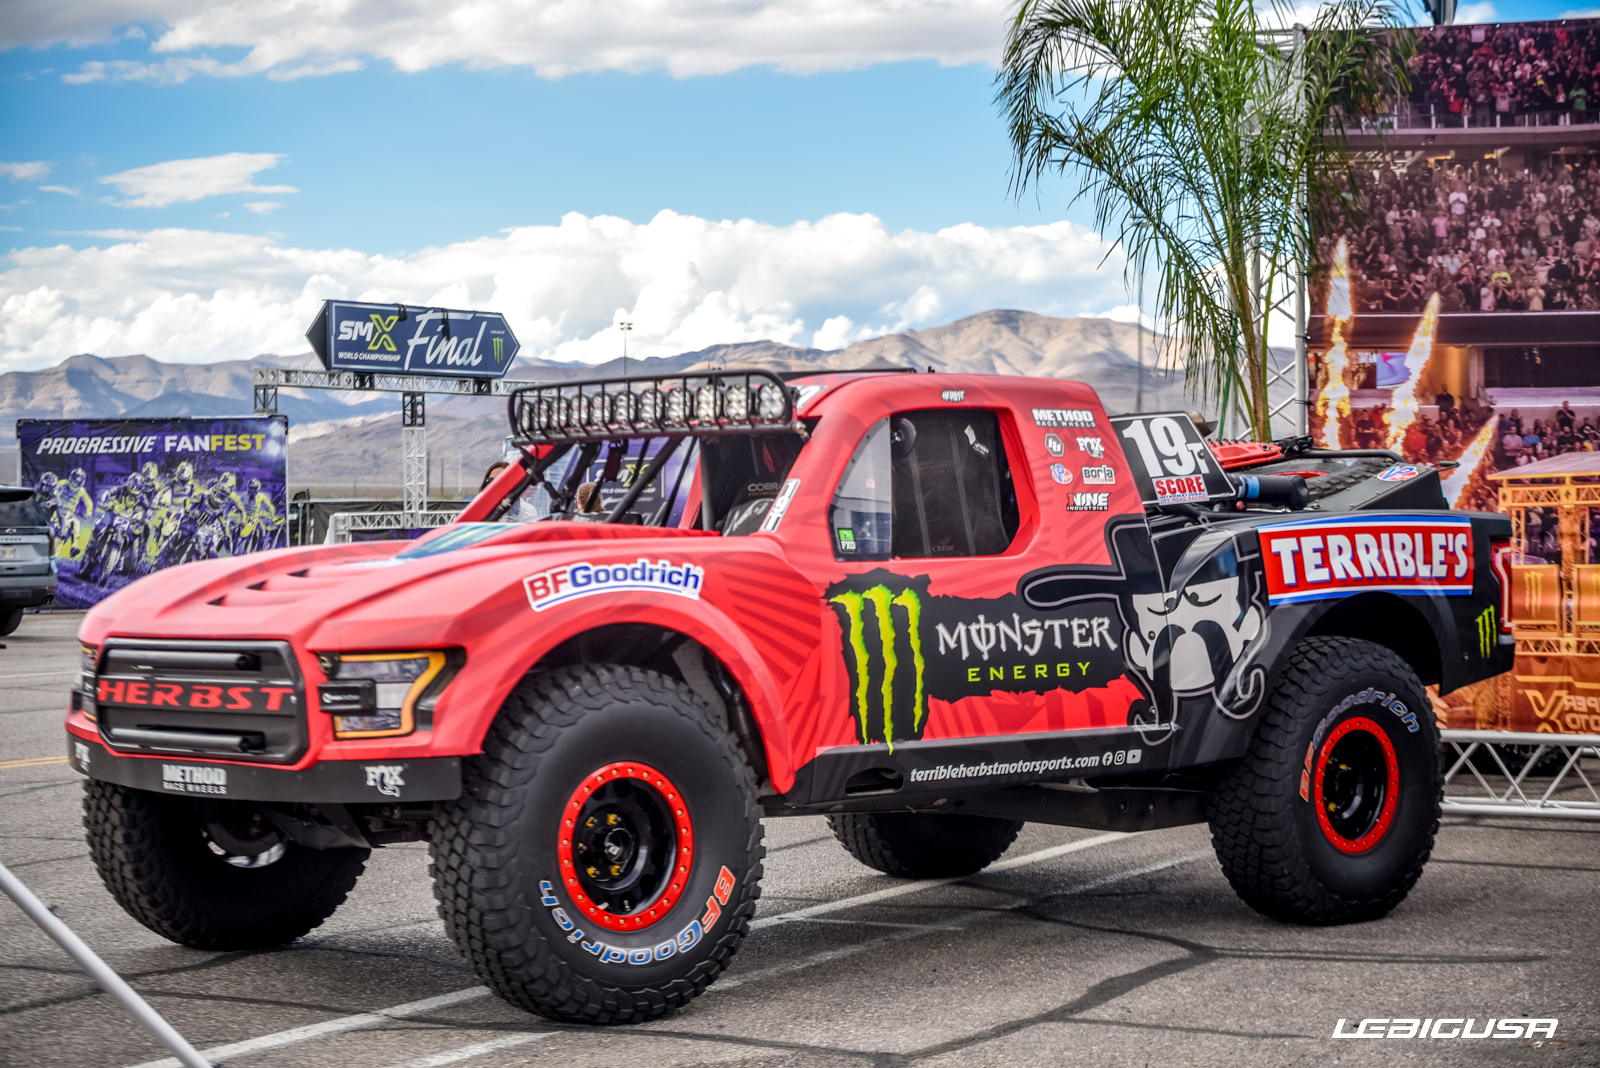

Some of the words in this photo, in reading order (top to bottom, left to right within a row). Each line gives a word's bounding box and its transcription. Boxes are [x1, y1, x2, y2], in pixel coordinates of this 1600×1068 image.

[337, 314, 399, 351] SMX
[404, 309, 488, 371] Final
[338, 352, 358, 360] WORLD
[359, 353, 401, 362] CHAMPIONSHIP
[1032, 409, 1094, 421] METHOD
[36, 436, 157, 455] PROGRESSIVE
[165, 434, 265, 452] FANFEST
[1076, 437, 1104, 456] FOX
[1155, 477, 1205, 496] SCORE
[1271, 533, 1469, 586] TERRIBLE'S
[528, 562, 699, 602] BFGoodrich
[936, 613, 1118, 661] MONSTER
[968, 662, 1091, 682] ENERGY
[97, 680, 295, 711] HERBST
[1299, 687, 1420, 803] BFGoodrich
[162, 764, 227, 785] METHOD
[365, 765, 405, 795] FOX
[910, 755, 1100, 782] terribleherbstmotorsports.com
[162, 782, 186, 792] RACE
[187, 783, 227, 794] WHEELS
[539, 865, 736, 964] BFGoodrich
